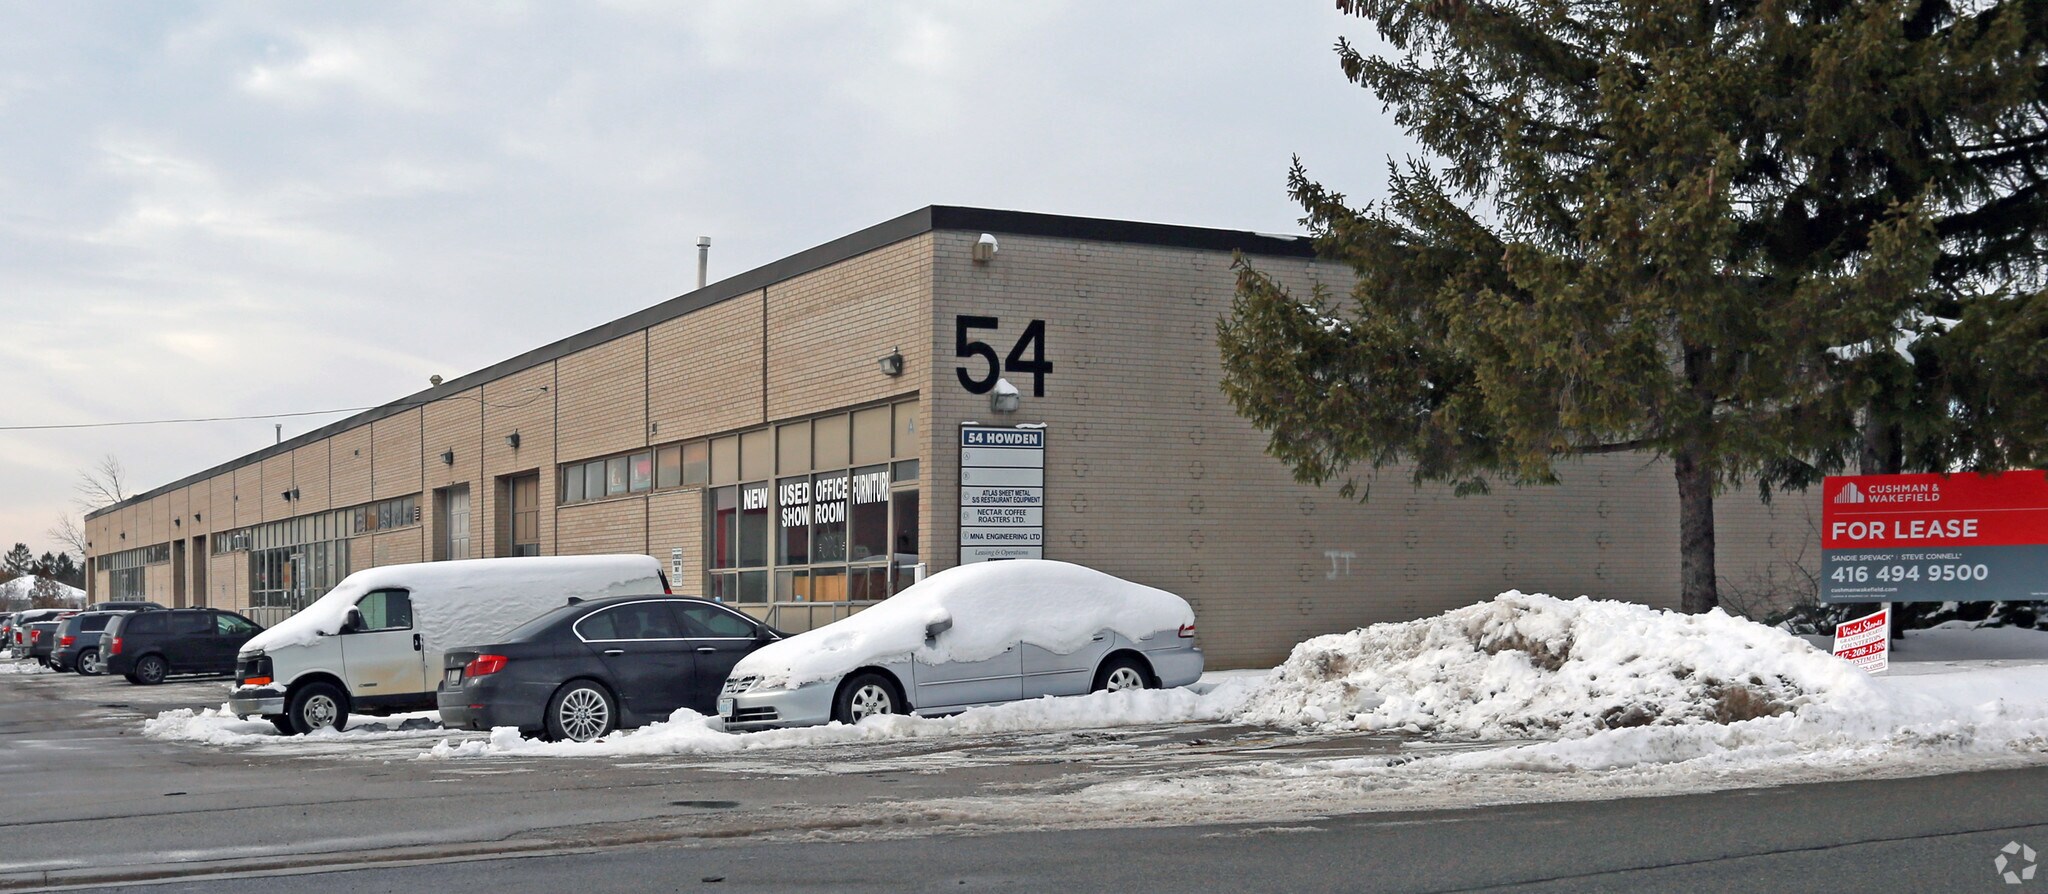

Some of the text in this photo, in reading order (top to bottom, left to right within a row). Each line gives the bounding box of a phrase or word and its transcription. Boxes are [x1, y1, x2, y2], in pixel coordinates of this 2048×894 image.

[956, 315, 1053, 398] 54
[968, 432, 1037, 444] 54 HOWDEN
[743, 487, 768, 510] NEW
[779, 482, 810, 506] USED
[815, 476, 848, 502] OFFICE
[982, 489, 1030, 497] ATLAS SHEET METAL
[1868, 483, 1939, 493] CUSHMAN &
[980, 496, 1012, 504] RESTAURANT
[1013, 496, 1040, 504] EQUIPMENT
[1868, 493, 1940, 503] WAKEFIELD
[781, 501, 845, 528] SHOW ROOM
[977, 508, 1026, 516] NECTAR COFFEE
[978, 516, 1026, 524] ROASTERS LTD.
[1832, 519, 1978, 540] FOR LEASE
[970, 533, 984, 541] MNA
[986, 533, 1028, 541] ENGINEERING
[1029, 533, 1041, 541] LTD
[1831, 554, 1858, 562] SANDIE
[1901, 553, 1924, 561] STEVE
[1831, 564, 1989, 583] 416 494 9500
